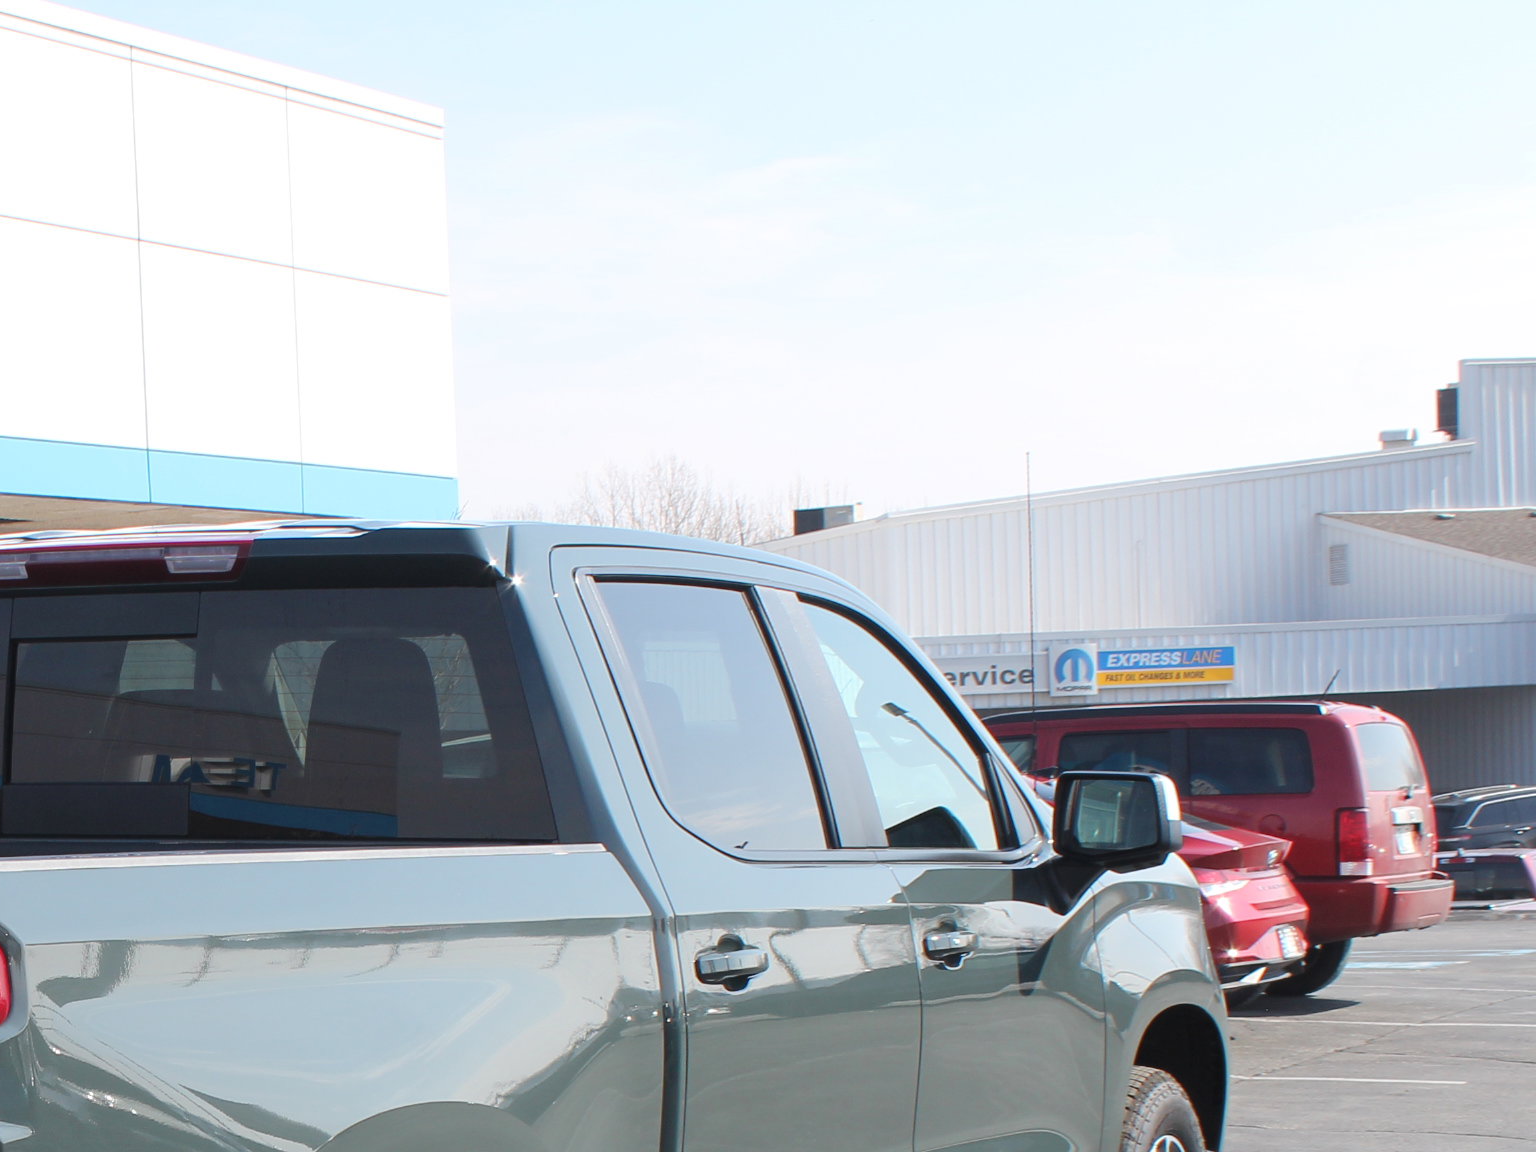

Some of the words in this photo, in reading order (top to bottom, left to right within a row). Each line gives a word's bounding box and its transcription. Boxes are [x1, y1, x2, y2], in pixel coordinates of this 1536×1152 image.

[944, 664, 1035, 687] ervice
[1106, 673, 1122, 682] FAST
[1139, 672, 1172, 681] CHANGES
[1185, 671, 1205, 680] MORE
